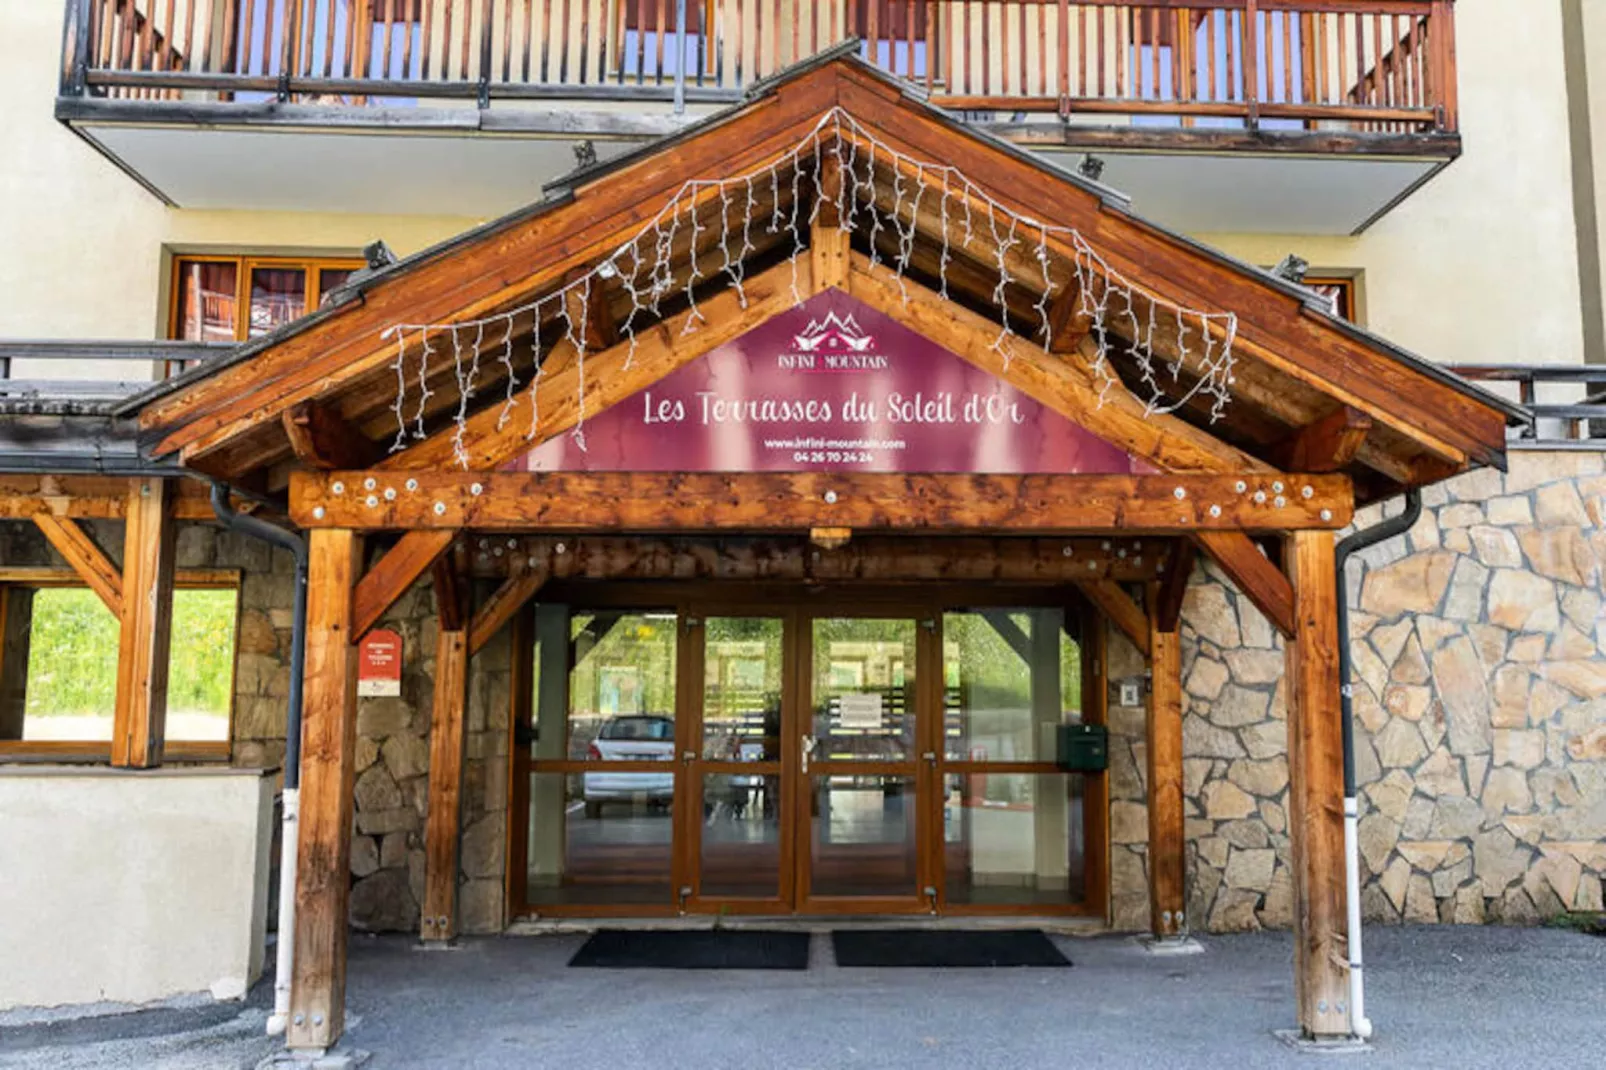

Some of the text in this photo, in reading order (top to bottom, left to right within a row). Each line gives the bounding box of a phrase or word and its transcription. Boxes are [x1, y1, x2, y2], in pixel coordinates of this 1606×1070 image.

[778, 355, 888, 368] INFINI MOUNTAIN
[643, 391, 1025, 425] Les Terrasses du Soleil d'Or
[763, 435, 906, 449] www.infini-mountain.com
[793, 451, 873, 462] 04 26 70 24 24
